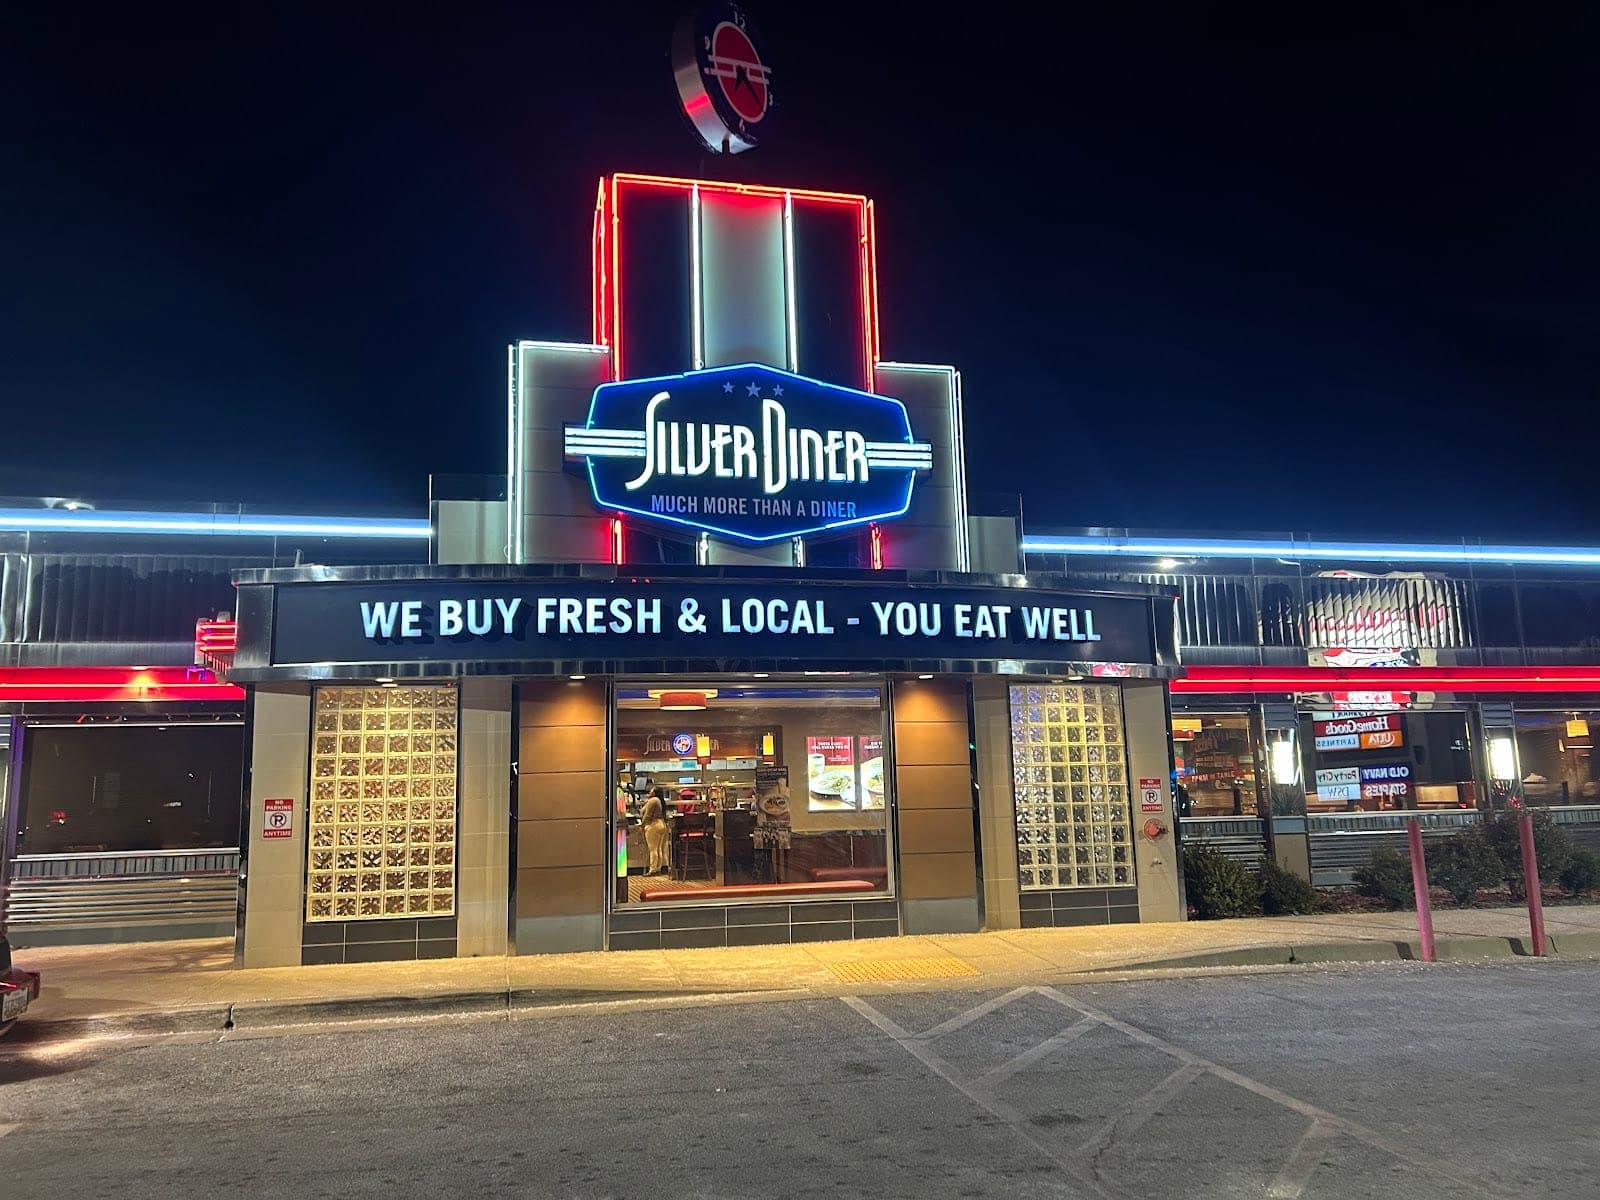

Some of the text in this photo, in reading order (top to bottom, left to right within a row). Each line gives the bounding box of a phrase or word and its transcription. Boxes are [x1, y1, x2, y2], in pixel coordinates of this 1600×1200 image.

[624, 390, 869, 494] SILVER DINER
[651, 494, 857, 519] MUCH MORE THAN A DINER
[360, 600, 422, 638] WE
[439, 598, 521, 636] BUY
[537, 598, 661, 634] FRESH
[677, 597, 707, 633] &
[721, 598, 834, 635] LOCAL
[871, 601, 941, 637] YOU
[954, 603, 1011, 639] EAT
[1021, 606, 1101, 642] WELL
